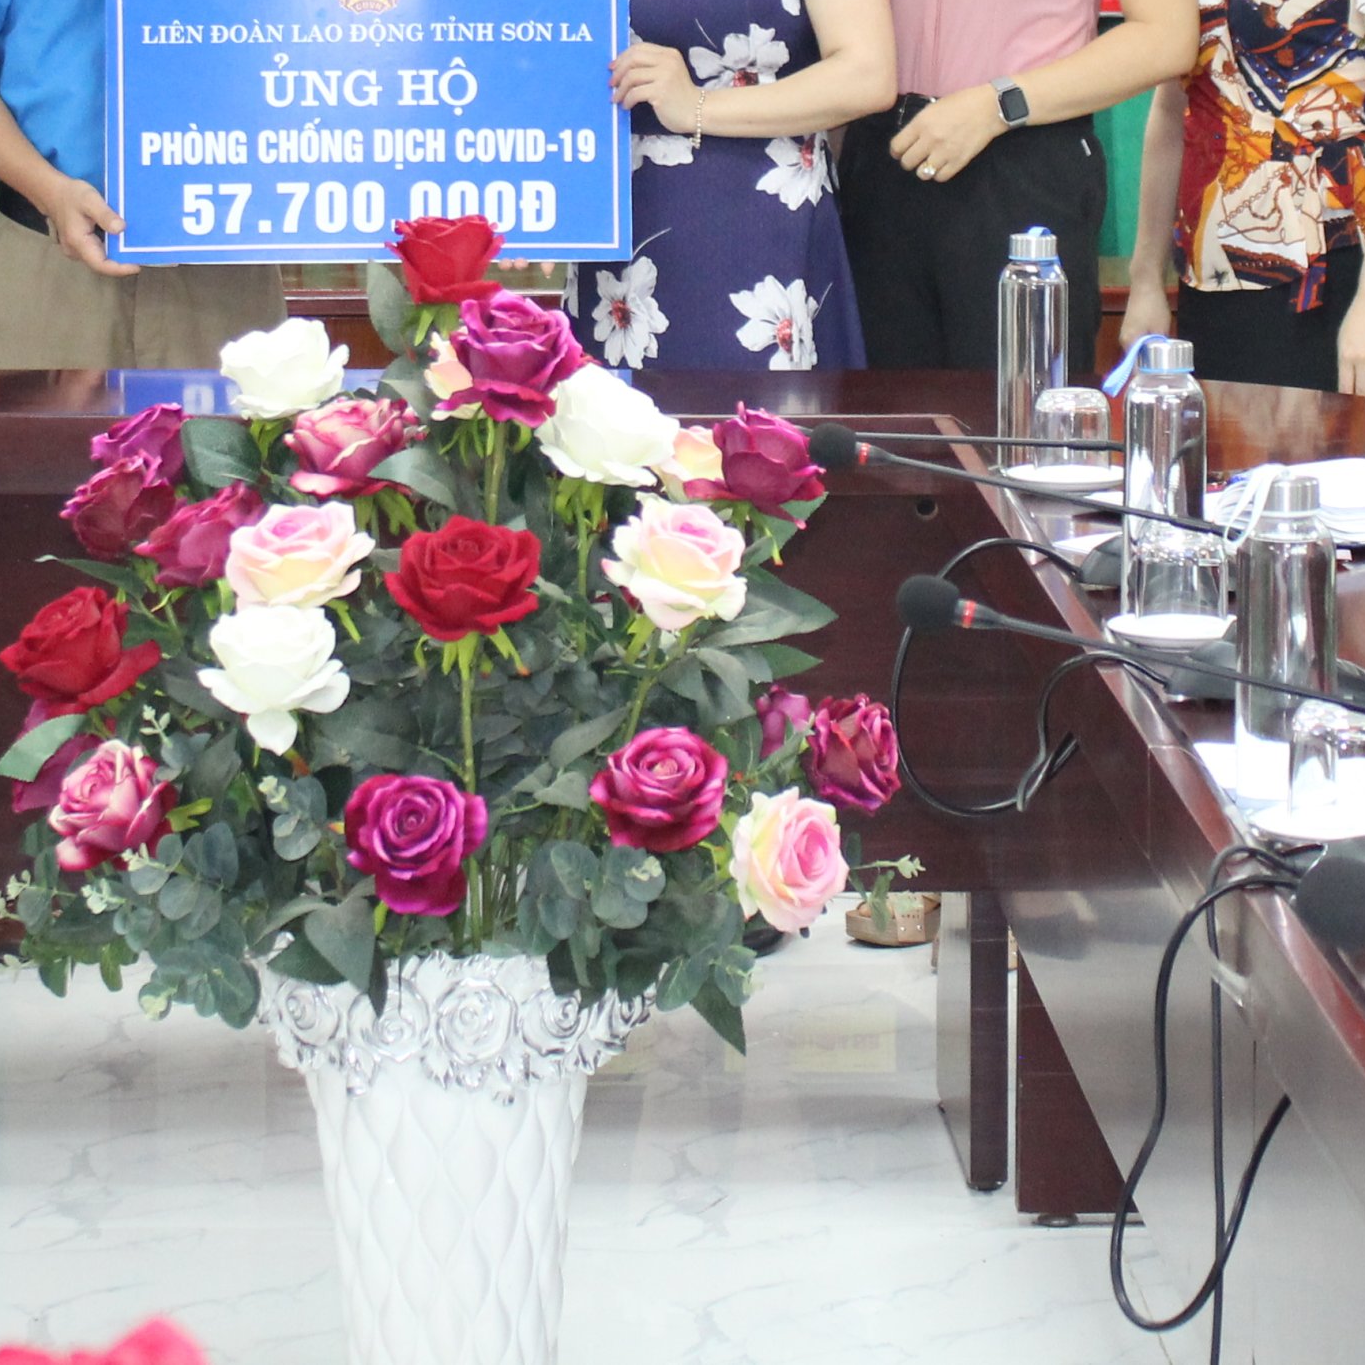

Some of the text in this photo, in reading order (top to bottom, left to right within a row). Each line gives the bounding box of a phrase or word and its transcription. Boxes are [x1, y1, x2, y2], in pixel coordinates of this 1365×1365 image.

[142, 15, 593, 48] LIÊN ĐOÀN LAO ĐỘNG TỈNH SƠN LA
[260, 52, 479, 116] ỦNG HỘ
[141, 117, 597, 170] PHÒNG CHỐNG DỊCH COVID-19
